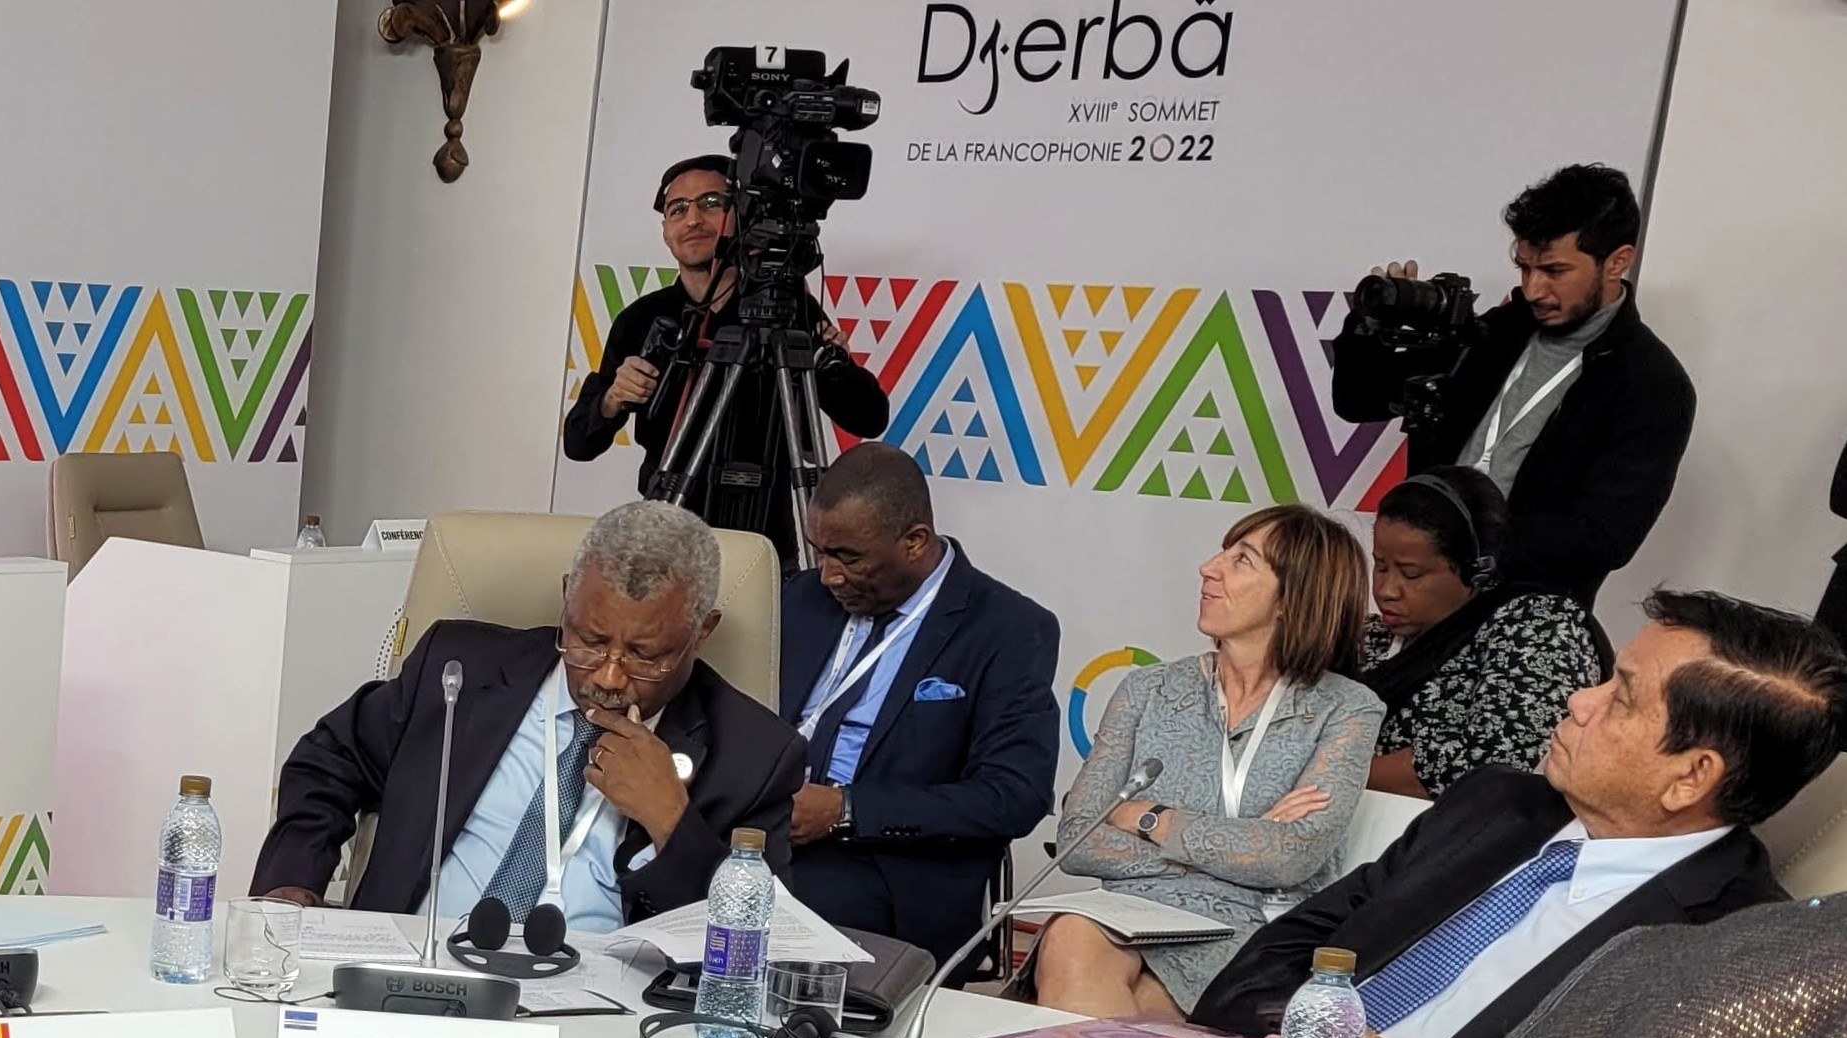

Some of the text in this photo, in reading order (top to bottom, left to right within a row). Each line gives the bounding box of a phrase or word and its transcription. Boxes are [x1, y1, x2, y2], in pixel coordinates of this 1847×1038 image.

[764, 46, 778, 63] 7
[751, 73, 791, 82] SONY
[1128, 100, 1220, 122] SOMMET
[906, 133, 1215, 162] DE LA FRANCOPHONIE 2022
[412, 980, 468, 997] BOSCH
